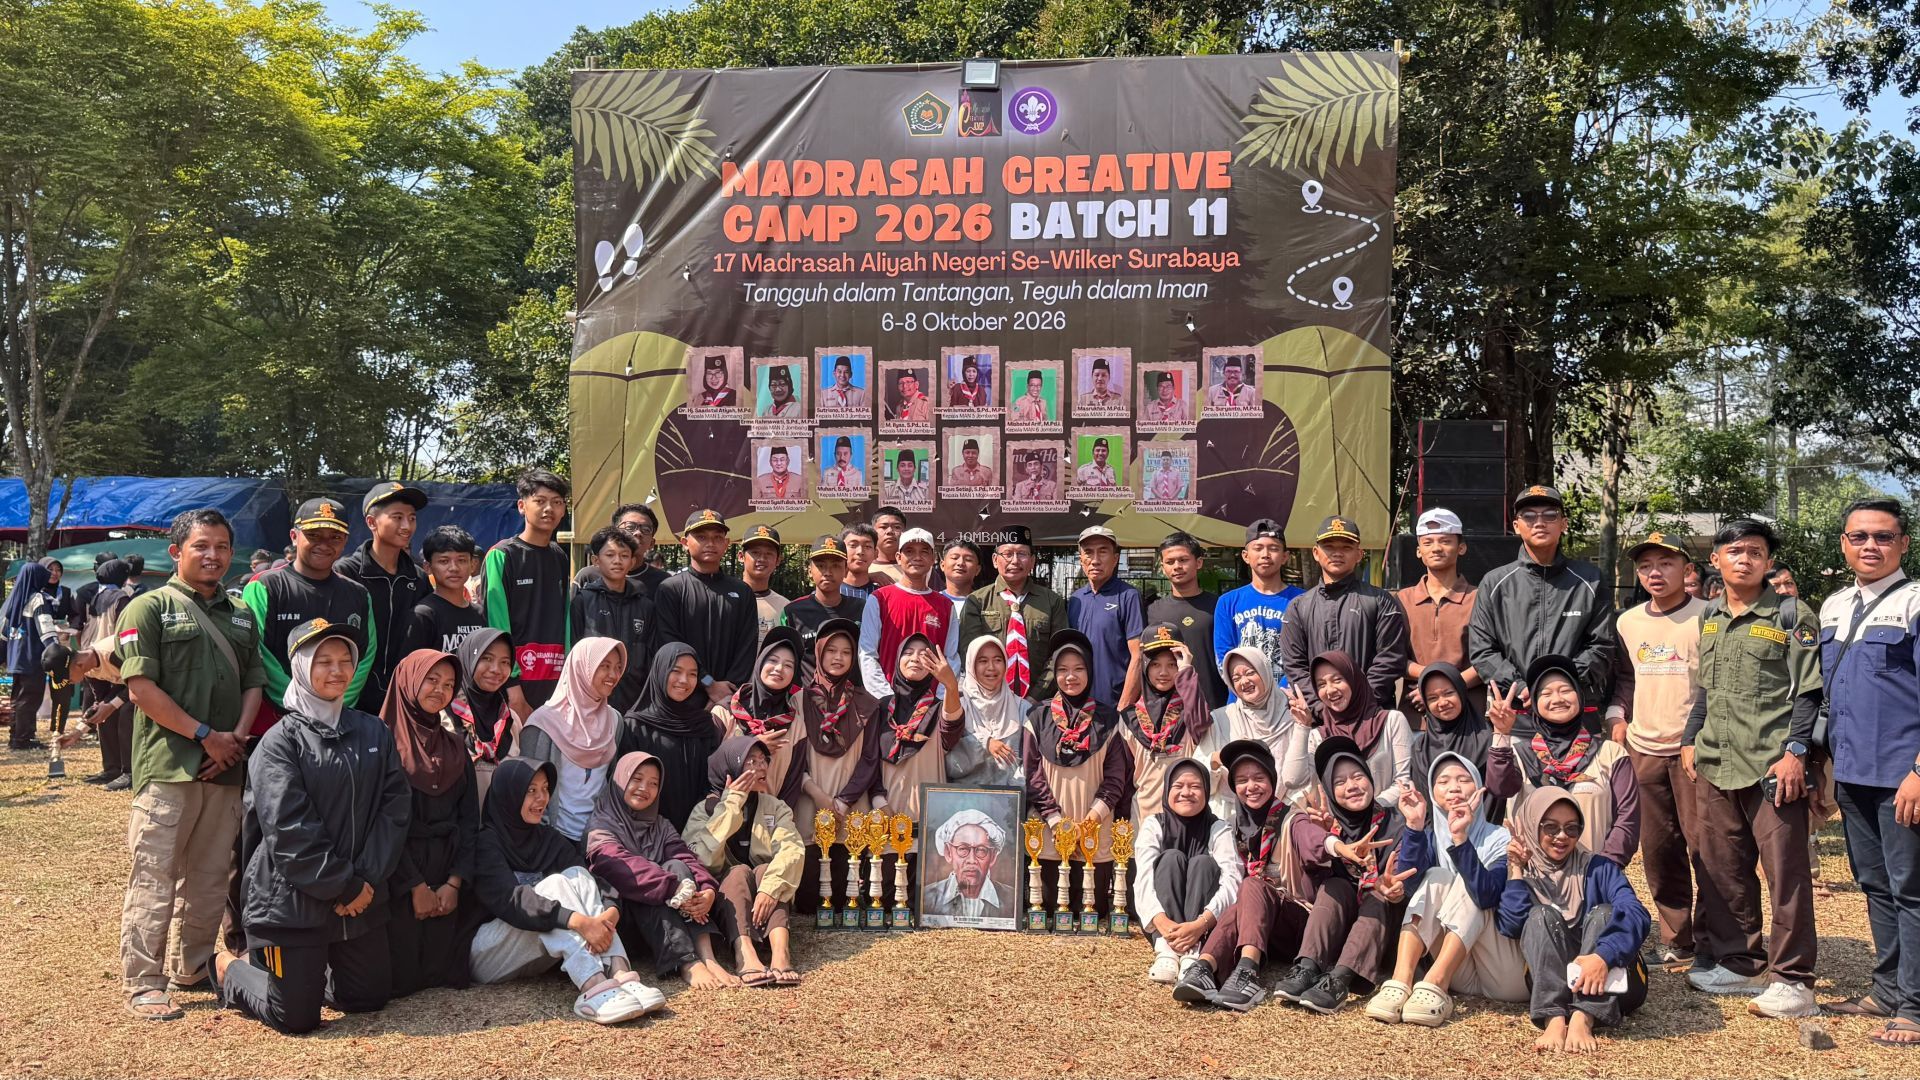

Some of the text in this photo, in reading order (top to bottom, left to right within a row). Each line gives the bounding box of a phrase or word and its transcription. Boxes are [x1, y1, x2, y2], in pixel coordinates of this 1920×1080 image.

[721, 150, 1232, 198] MADRASAH CREATIVE
[723, 197, 1229, 243] CAMP 2026 BATCH 11
[713, 247, 1241, 276] 17 Madrasah Aliyah Negeri Se-Wilker Surabaya
[743, 279, 1209, 306] Tangguh dalam Tantangan, Teguh dalam Iman
[881, 311, 1067, 332] 6-8 Oktober 2026
